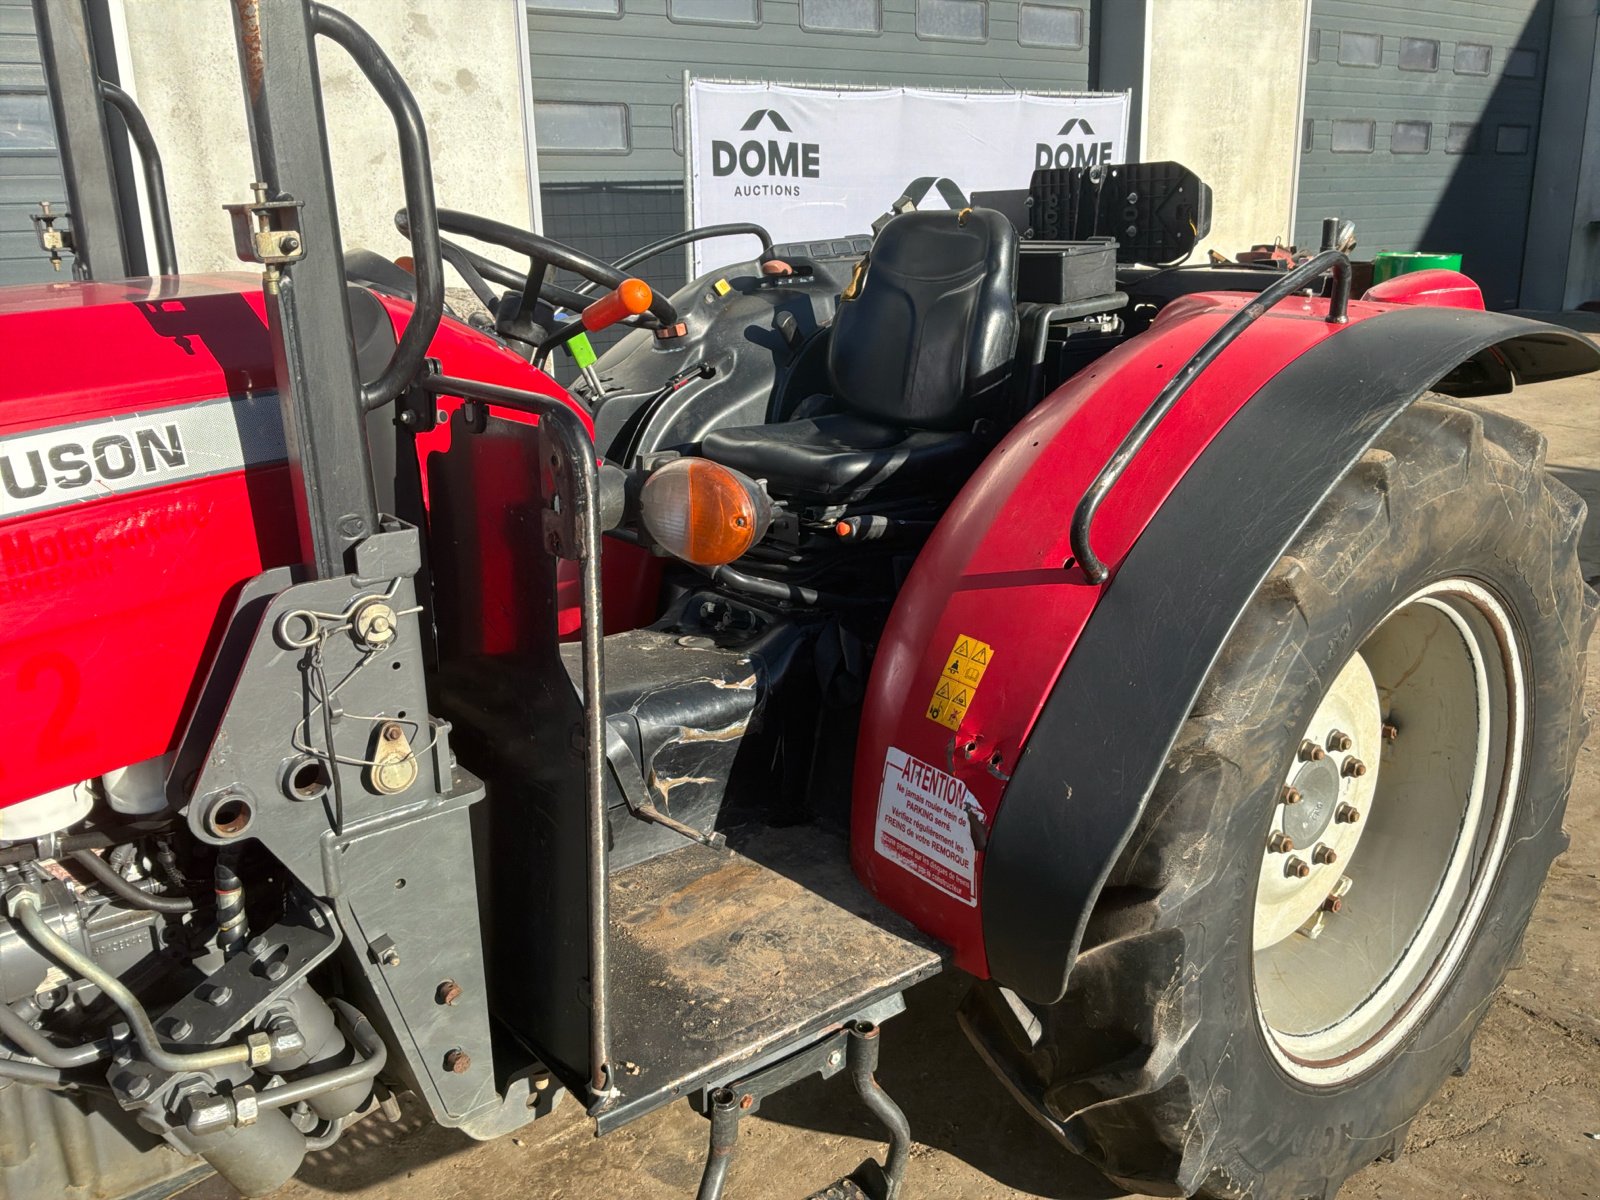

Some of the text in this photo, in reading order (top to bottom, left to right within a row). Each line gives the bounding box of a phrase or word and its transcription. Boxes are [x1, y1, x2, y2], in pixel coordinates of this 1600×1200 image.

[712, 140, 819, 178] DOME
[1035, 142, 1112, 170] DOME
[734, 184, 800, 197] AUCTIONS
[0, 424, 186, 499] USON
[896, 783, 966, 827] Ne jamais rouler frein de
[902, 757, 967, 809] ATTENTION
[891, 806, 964, 854] Vérifiez régulièrement les
[906, 800, 933, 822] PARKING
[884, 815, 969, 869] FREINS de votre REMORQUE
